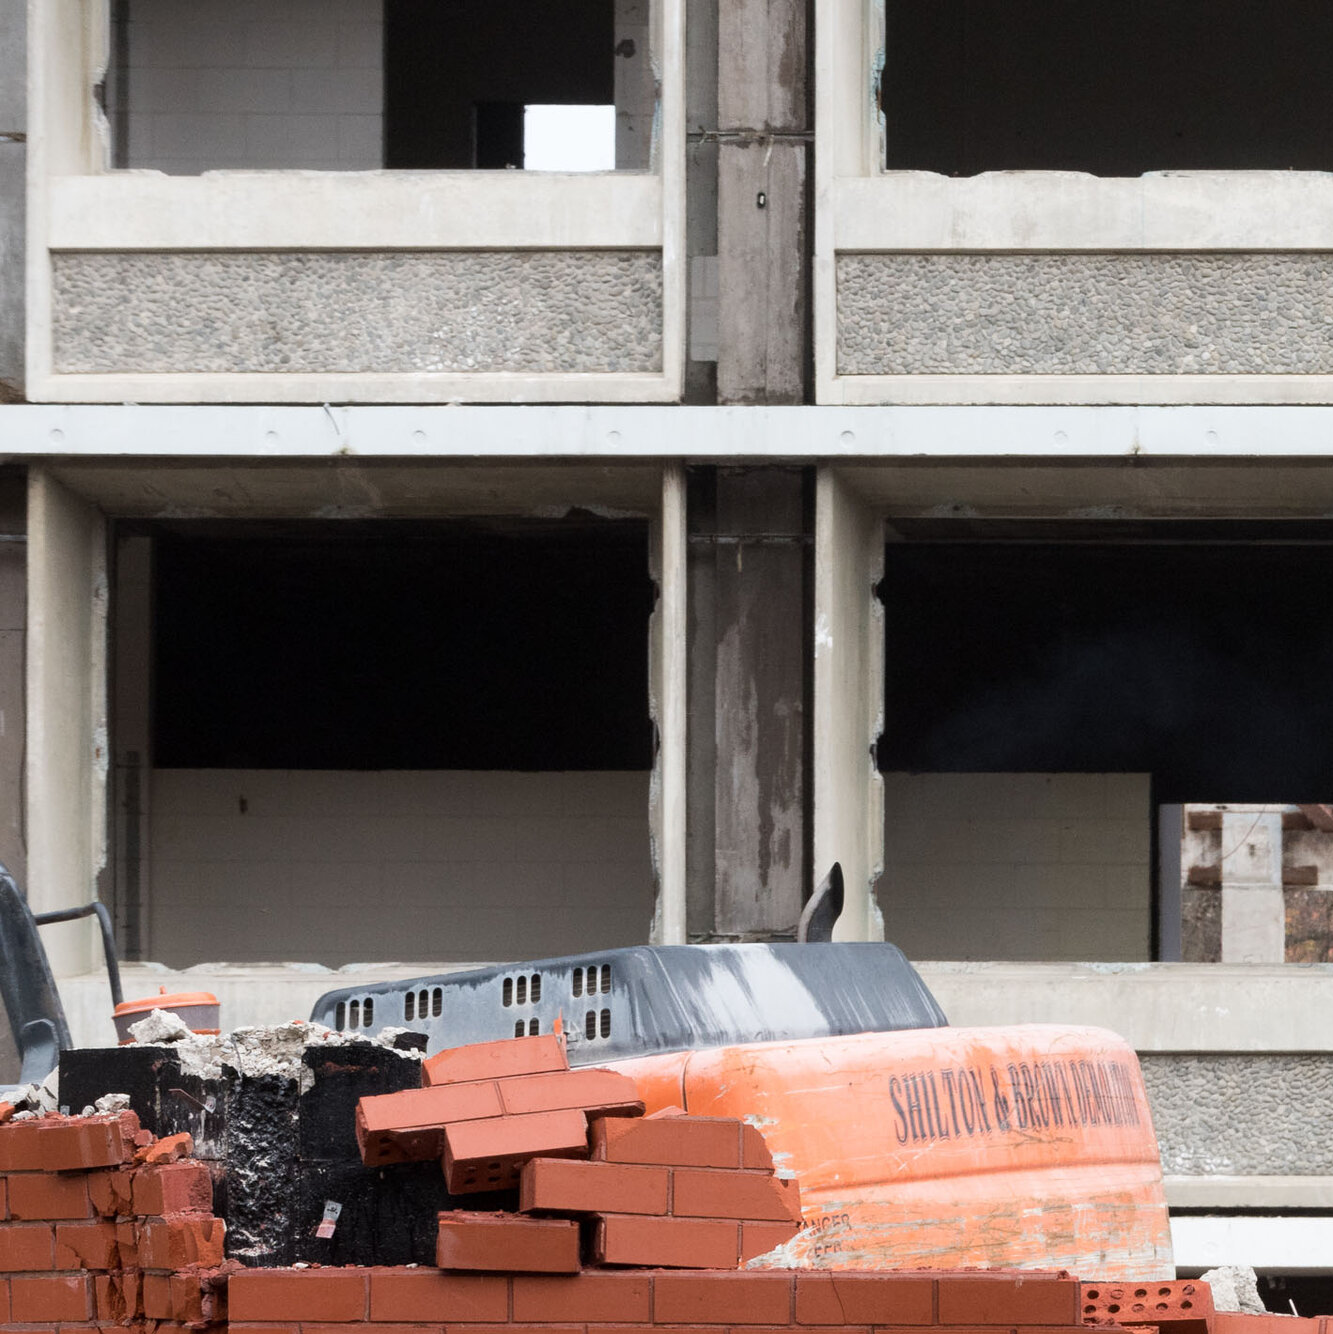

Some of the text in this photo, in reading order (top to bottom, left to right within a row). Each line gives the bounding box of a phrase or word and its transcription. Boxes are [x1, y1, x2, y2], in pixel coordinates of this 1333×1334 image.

[889, 1065, 992, 1145] SHILTON
[990, 1063, 1011, 1134] &
[1006, 1059, 1079, 1130] BROWN
